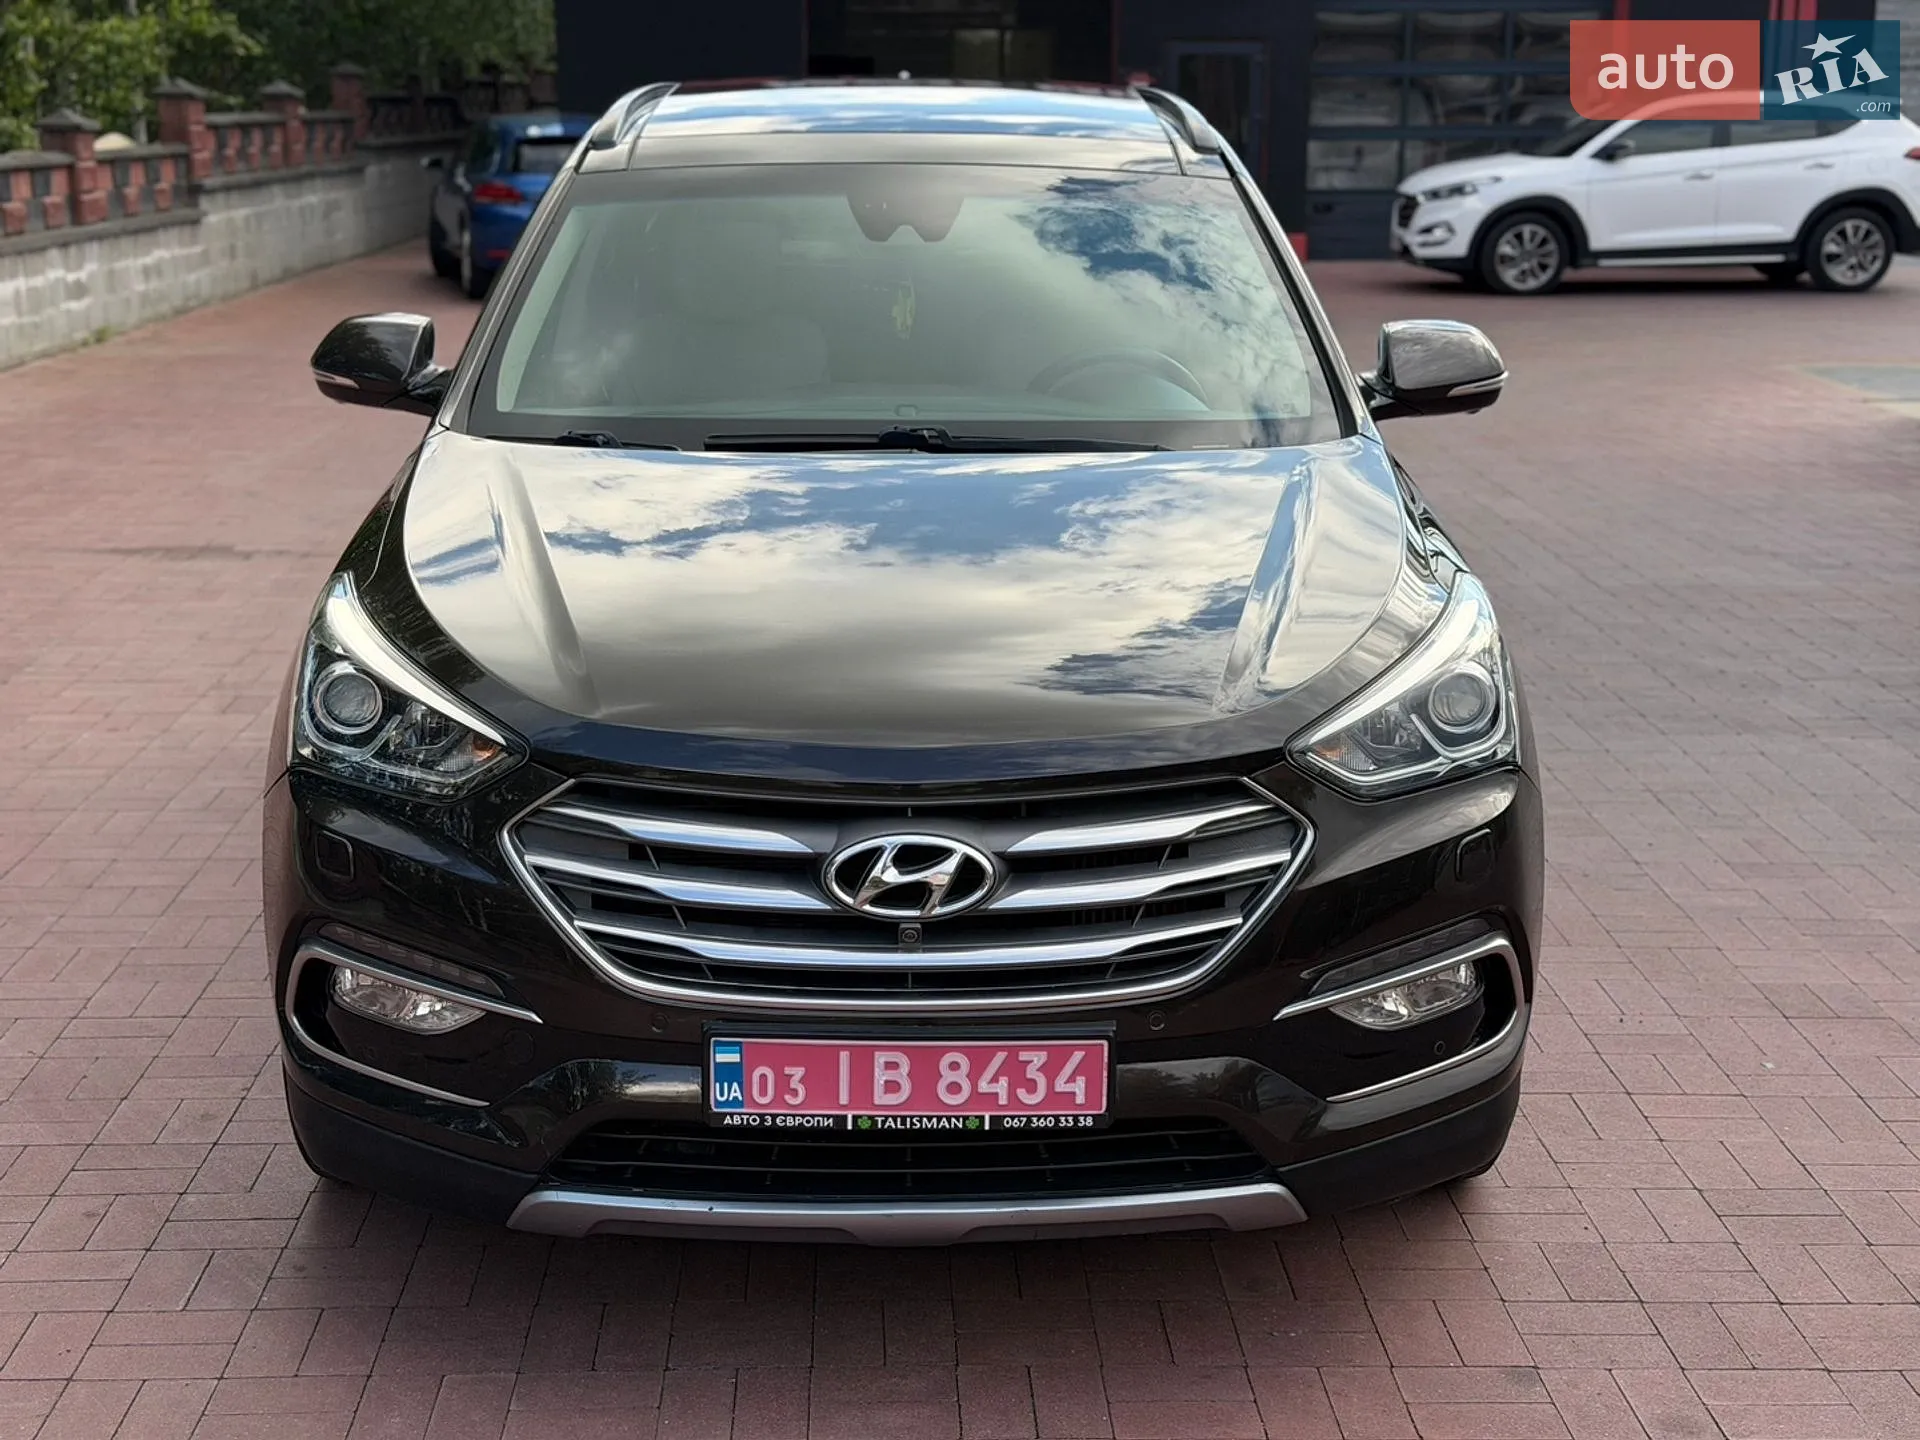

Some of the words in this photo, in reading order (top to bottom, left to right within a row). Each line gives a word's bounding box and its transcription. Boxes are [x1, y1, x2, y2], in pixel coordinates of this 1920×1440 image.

[752, 1066, 806, 1105] 03
[936, 1051, 1087, 1106] 8434
[715, 1082, 742, 1102] UA
[723, 1115, 760, 1126] АВТО
[775, 1116, 834, 1127] ЄВРОПИ
[874, 1117, 963, 1129] TALISMAN
[1003, 1117, 1027, 1128] 067
[1030, 1116, 1055, 1128] 360
[1058, 1116, 1075, 1127] 33
[1077, 1116, 1094, 1127] 38
